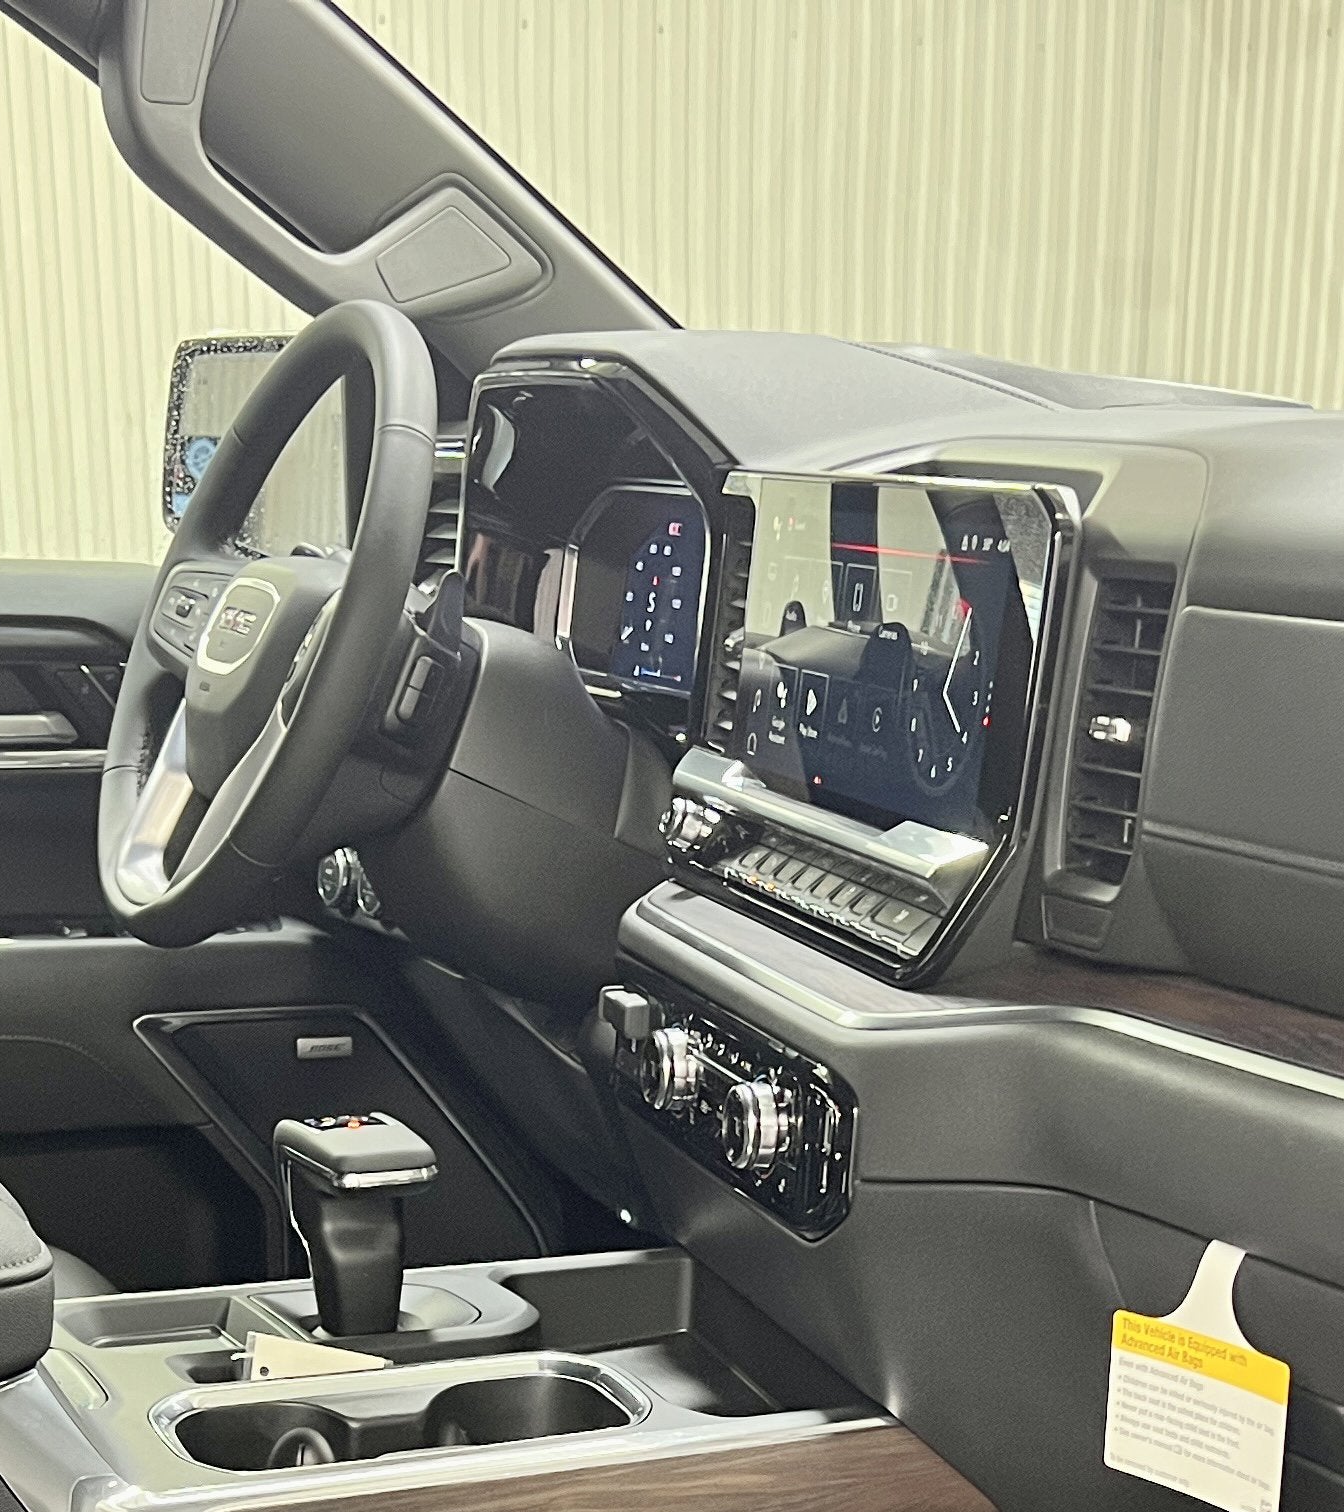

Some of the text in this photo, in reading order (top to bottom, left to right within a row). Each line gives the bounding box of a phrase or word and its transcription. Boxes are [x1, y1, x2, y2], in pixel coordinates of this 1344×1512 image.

[1121, 1333, 1165, 1357] Advanced
[1122, 1317, 1141, 1334] This
[1143, 1323, 1175, 1343] Vehicle
[1187, 1336, 1227, 1360] Equipped
